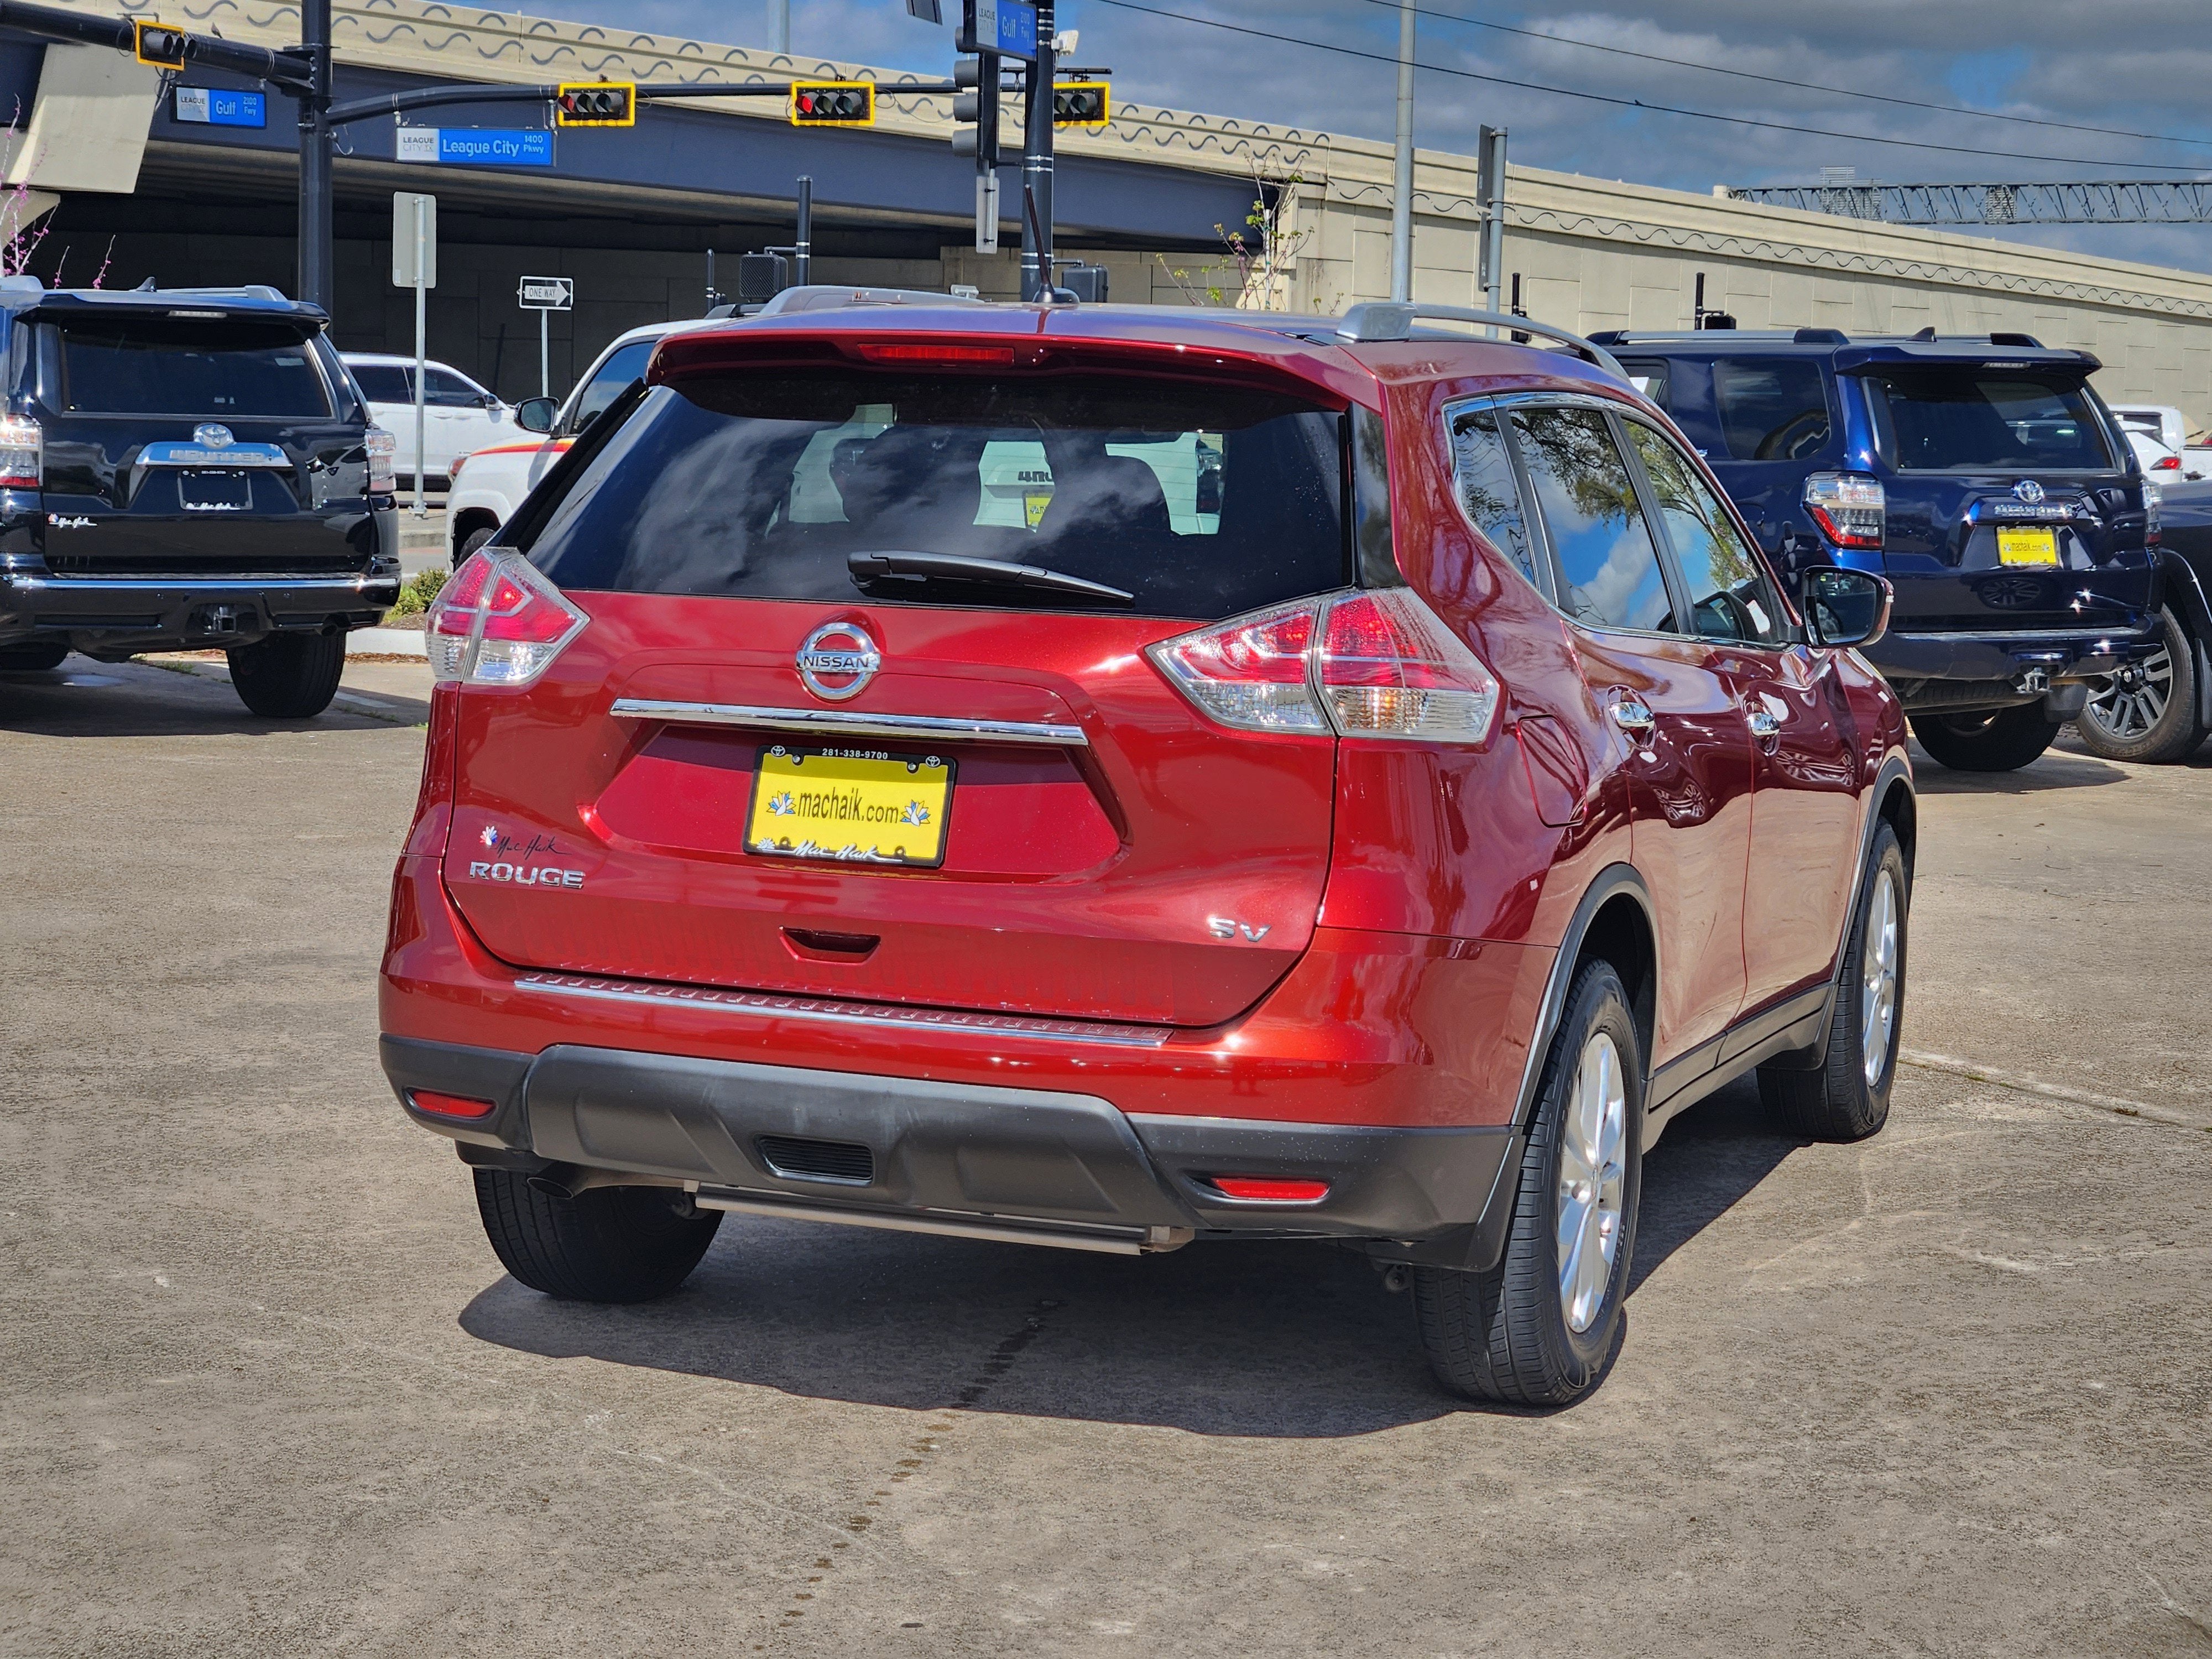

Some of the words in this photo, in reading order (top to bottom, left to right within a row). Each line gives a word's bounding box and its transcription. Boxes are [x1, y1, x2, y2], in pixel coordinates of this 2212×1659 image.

[1002, 15, 1016, 38] Gulf
[216, 100, 236, 115] Gulf
[244, 106, 257, 116] Fwy
[443, 139, 490, 157] League
[493, 139, 520, 157] City
[523, 144, 544, 155] Pkwy
[529, 288, 542, 297] ONE
[545, 289, 556, 298] WAY
[804, 656, 869, 667] NISSAN
[822, 748, 888, 759] 281-338-9700
[797, 787, 899, 823] machaik.com
[495, 836, 523, 858] Mac
[524, 834, 572, 860] Haik
[792, 839, 834, 856] Mac
[469, 861, 586, 889] ROUGE
[1208, 916, 1271, 942] SV
